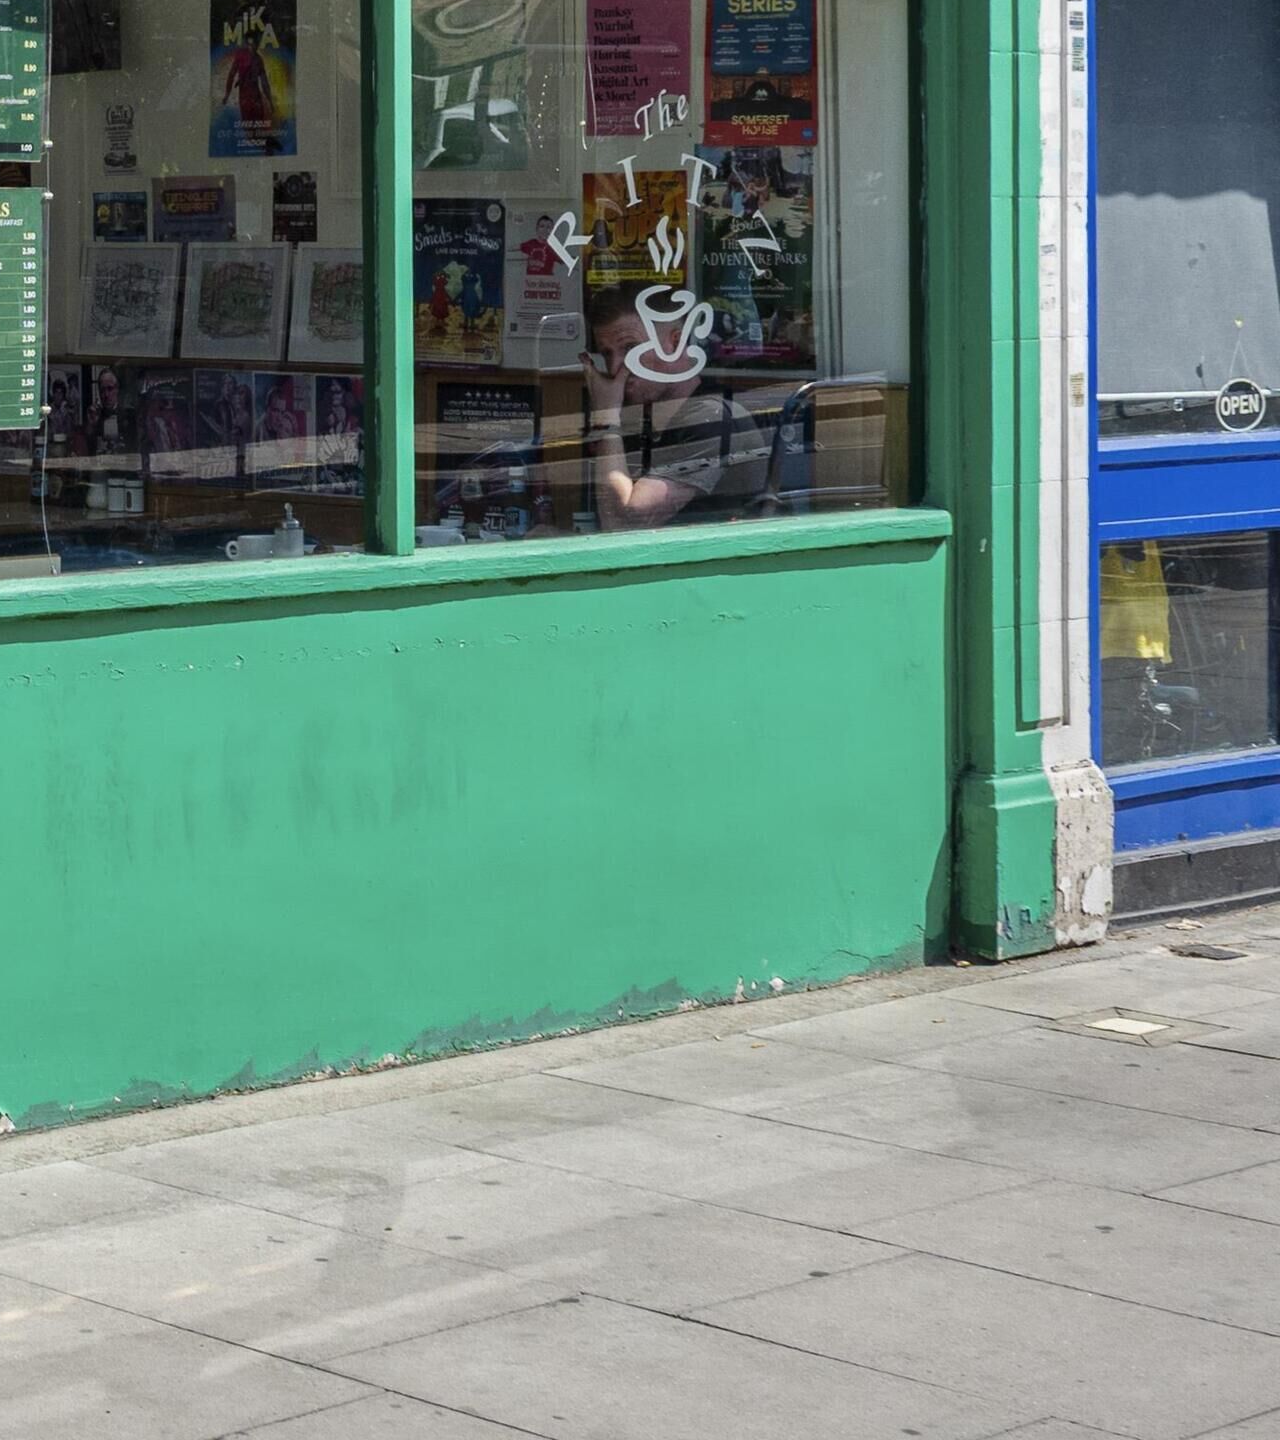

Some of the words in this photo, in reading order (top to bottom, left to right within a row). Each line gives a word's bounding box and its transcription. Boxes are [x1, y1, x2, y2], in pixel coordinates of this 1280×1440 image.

[224, 6, 280, 49] MIKA
[634, 87, 688, 142] The
[731, 115, 790, 126] SOMERSET
[1220, 393, 1259, 417] OPEN
